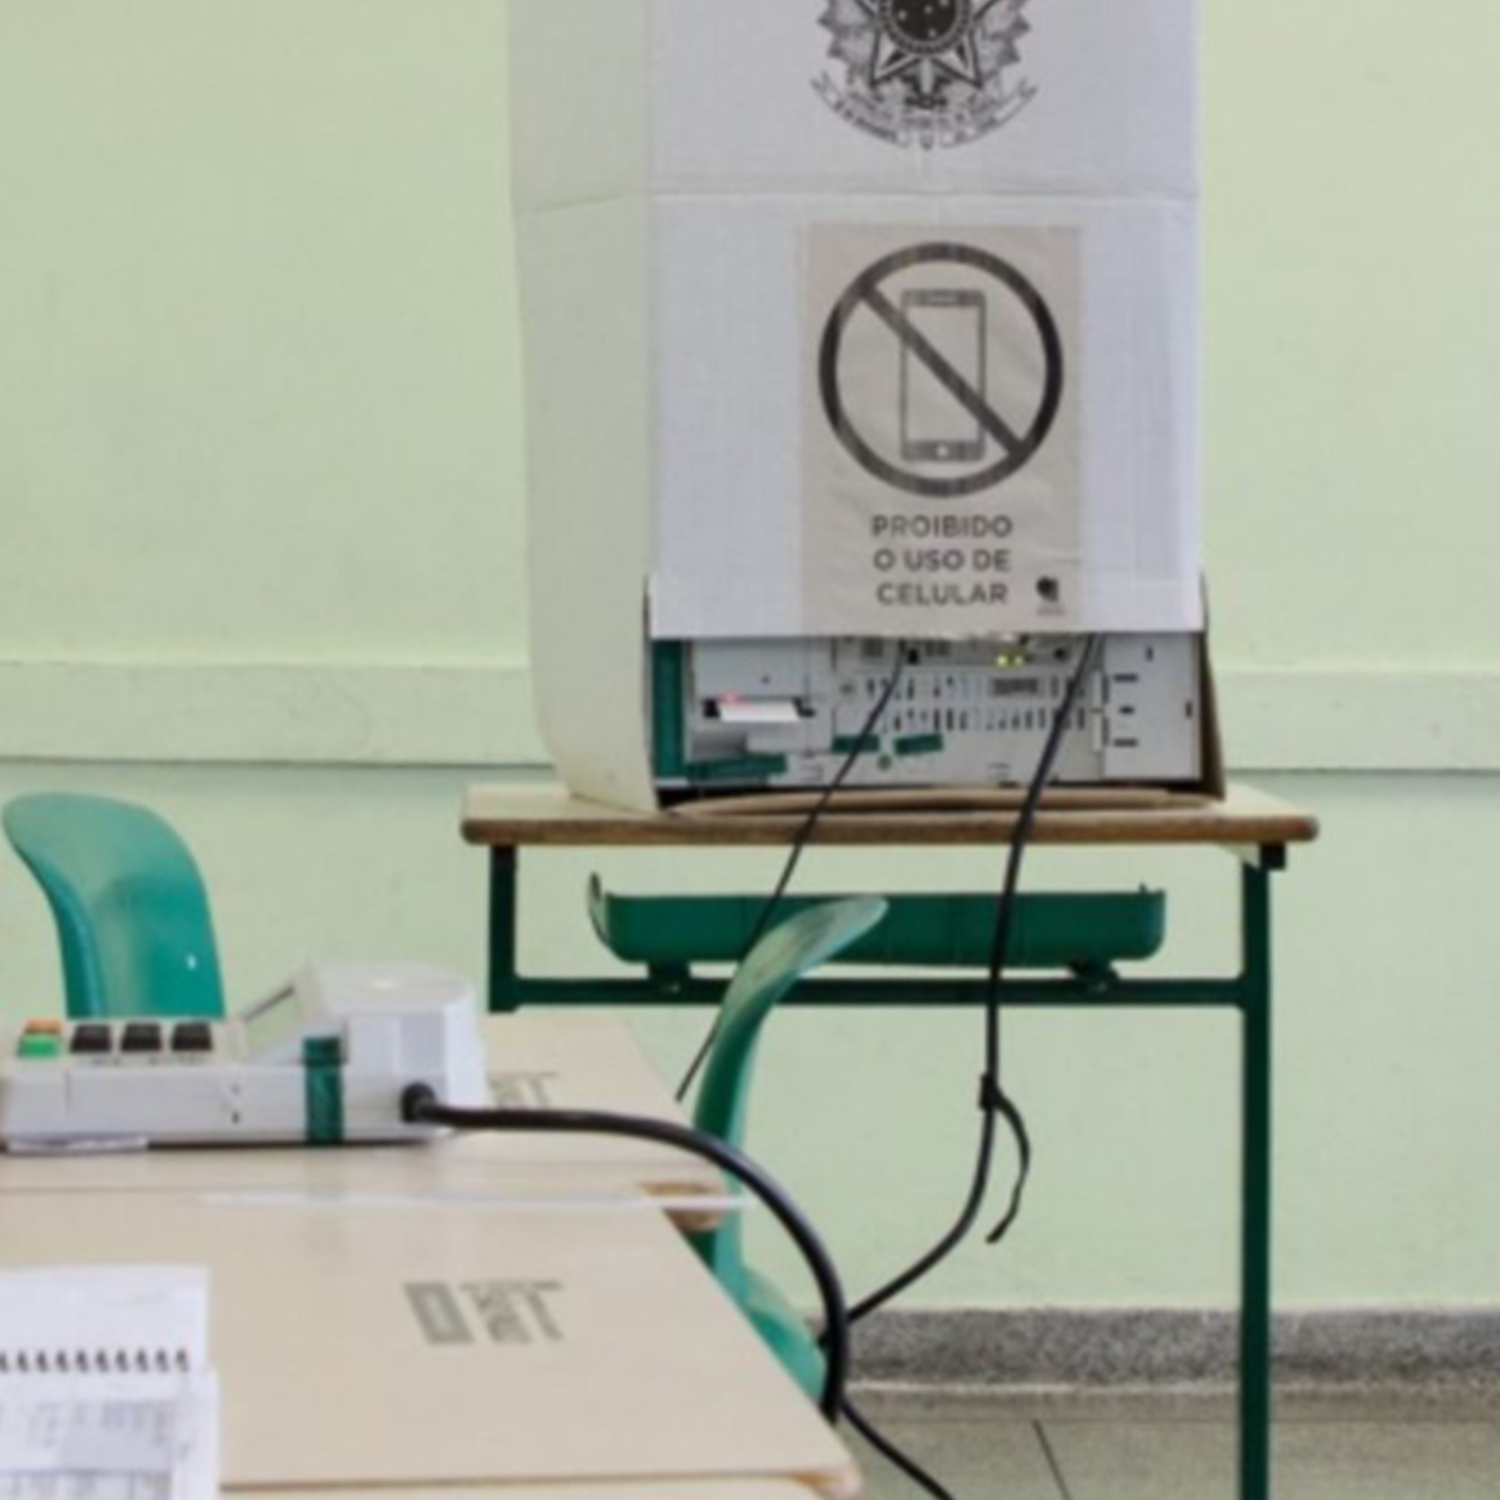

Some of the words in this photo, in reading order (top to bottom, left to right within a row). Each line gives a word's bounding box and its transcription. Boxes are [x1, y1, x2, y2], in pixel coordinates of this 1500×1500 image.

[871, 514, 1013, 538] PROIBIDO
[873, 549, 896, 572] O
[903, 549, 965, 572] USO
[972, 549, 1011, 572] DE
[876, 583, 1009, 606] CELULAR
